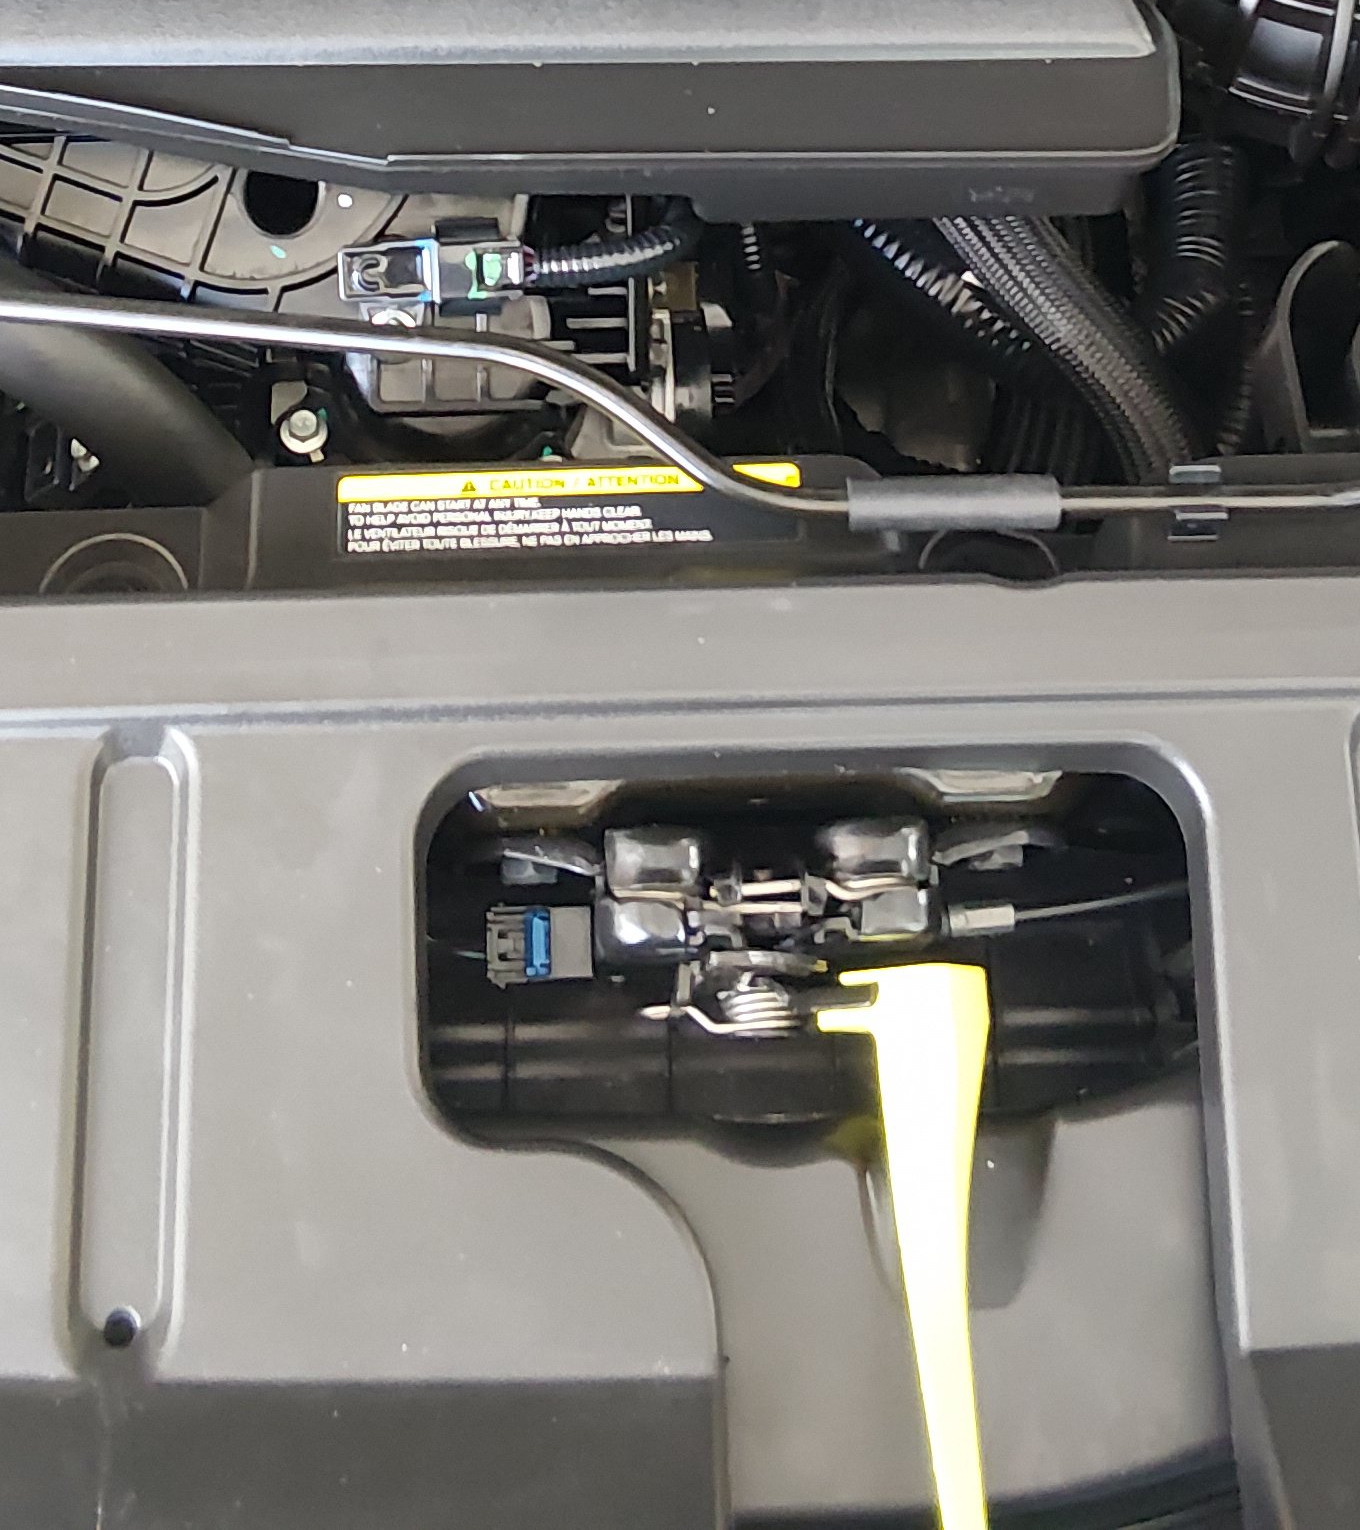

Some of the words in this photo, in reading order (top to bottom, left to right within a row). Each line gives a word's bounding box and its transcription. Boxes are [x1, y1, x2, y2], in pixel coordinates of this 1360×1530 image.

[489, 478, 565, 491] CAUTION
[587, 474, 680, 486] ATTENTION
[348, 515, 364, 526] TO
[347, 528, 362, 540] LE
